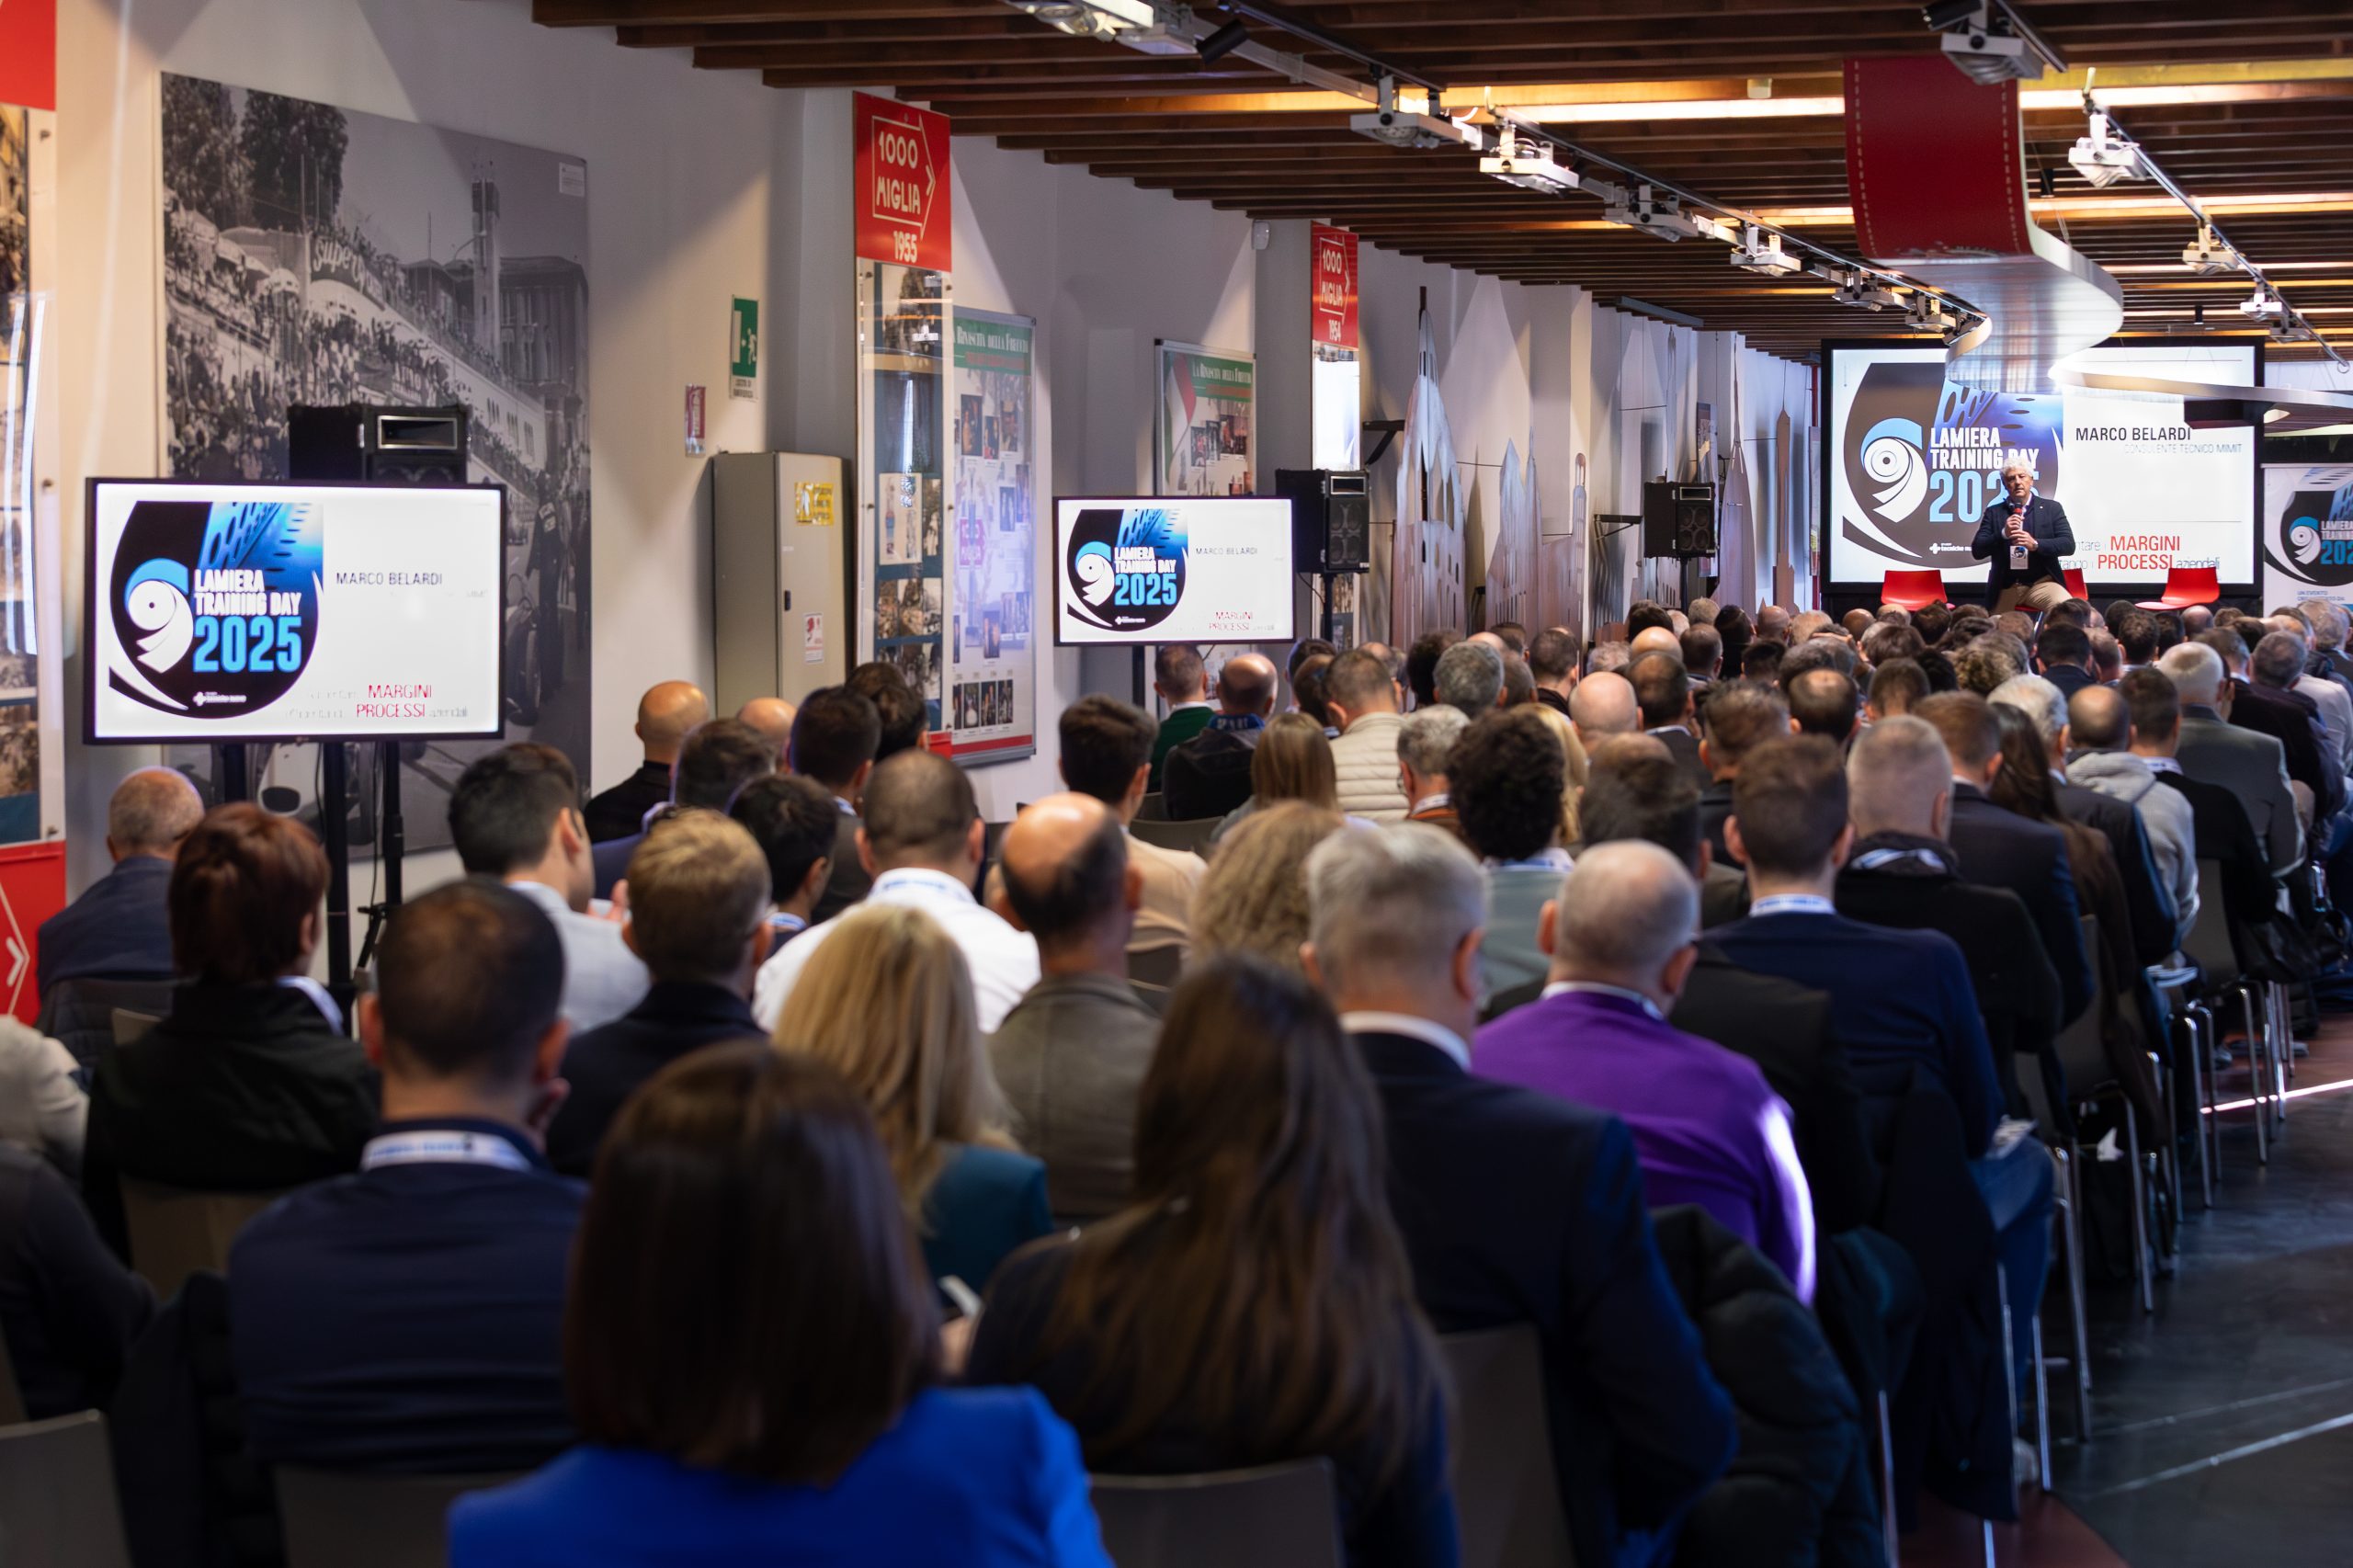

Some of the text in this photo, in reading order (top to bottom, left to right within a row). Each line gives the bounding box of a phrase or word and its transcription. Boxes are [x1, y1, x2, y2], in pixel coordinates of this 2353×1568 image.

[879, 131, 918, 169] 1000
[876, 176, 921, 214] MIGLIA
[893, 230, 917, 263] 1955
[1323, 248, 1342, 275] 1000
[1322, 281, 1343, 307] MIGLIA
[1930, 427, 2001, 448] LAMIERA
[2075, 427, 2191, 441] MARCO BELARDI
[1930, 449, 2003, 469] TRAINING
[2179, 444, 2214, 453] TECNICO
[1195, 547, 1223, 555] MARCO
[2110, 536, 2180, 551] MARGINI
[2097, 554, 2173, 570] PROCESSI
[194, 569, 265, 593] LAMIERA
[336, 572, 442, 585] MARCO BELARDI
[1114, 573, 1176, 606] 2025
[194, 592, 301, 616] TRAINING DAY
[193, 615, 301, 673] 2025
[368, 685, 432, 699] MARGINI
[356, 703, 426, 718] PROCESSI
